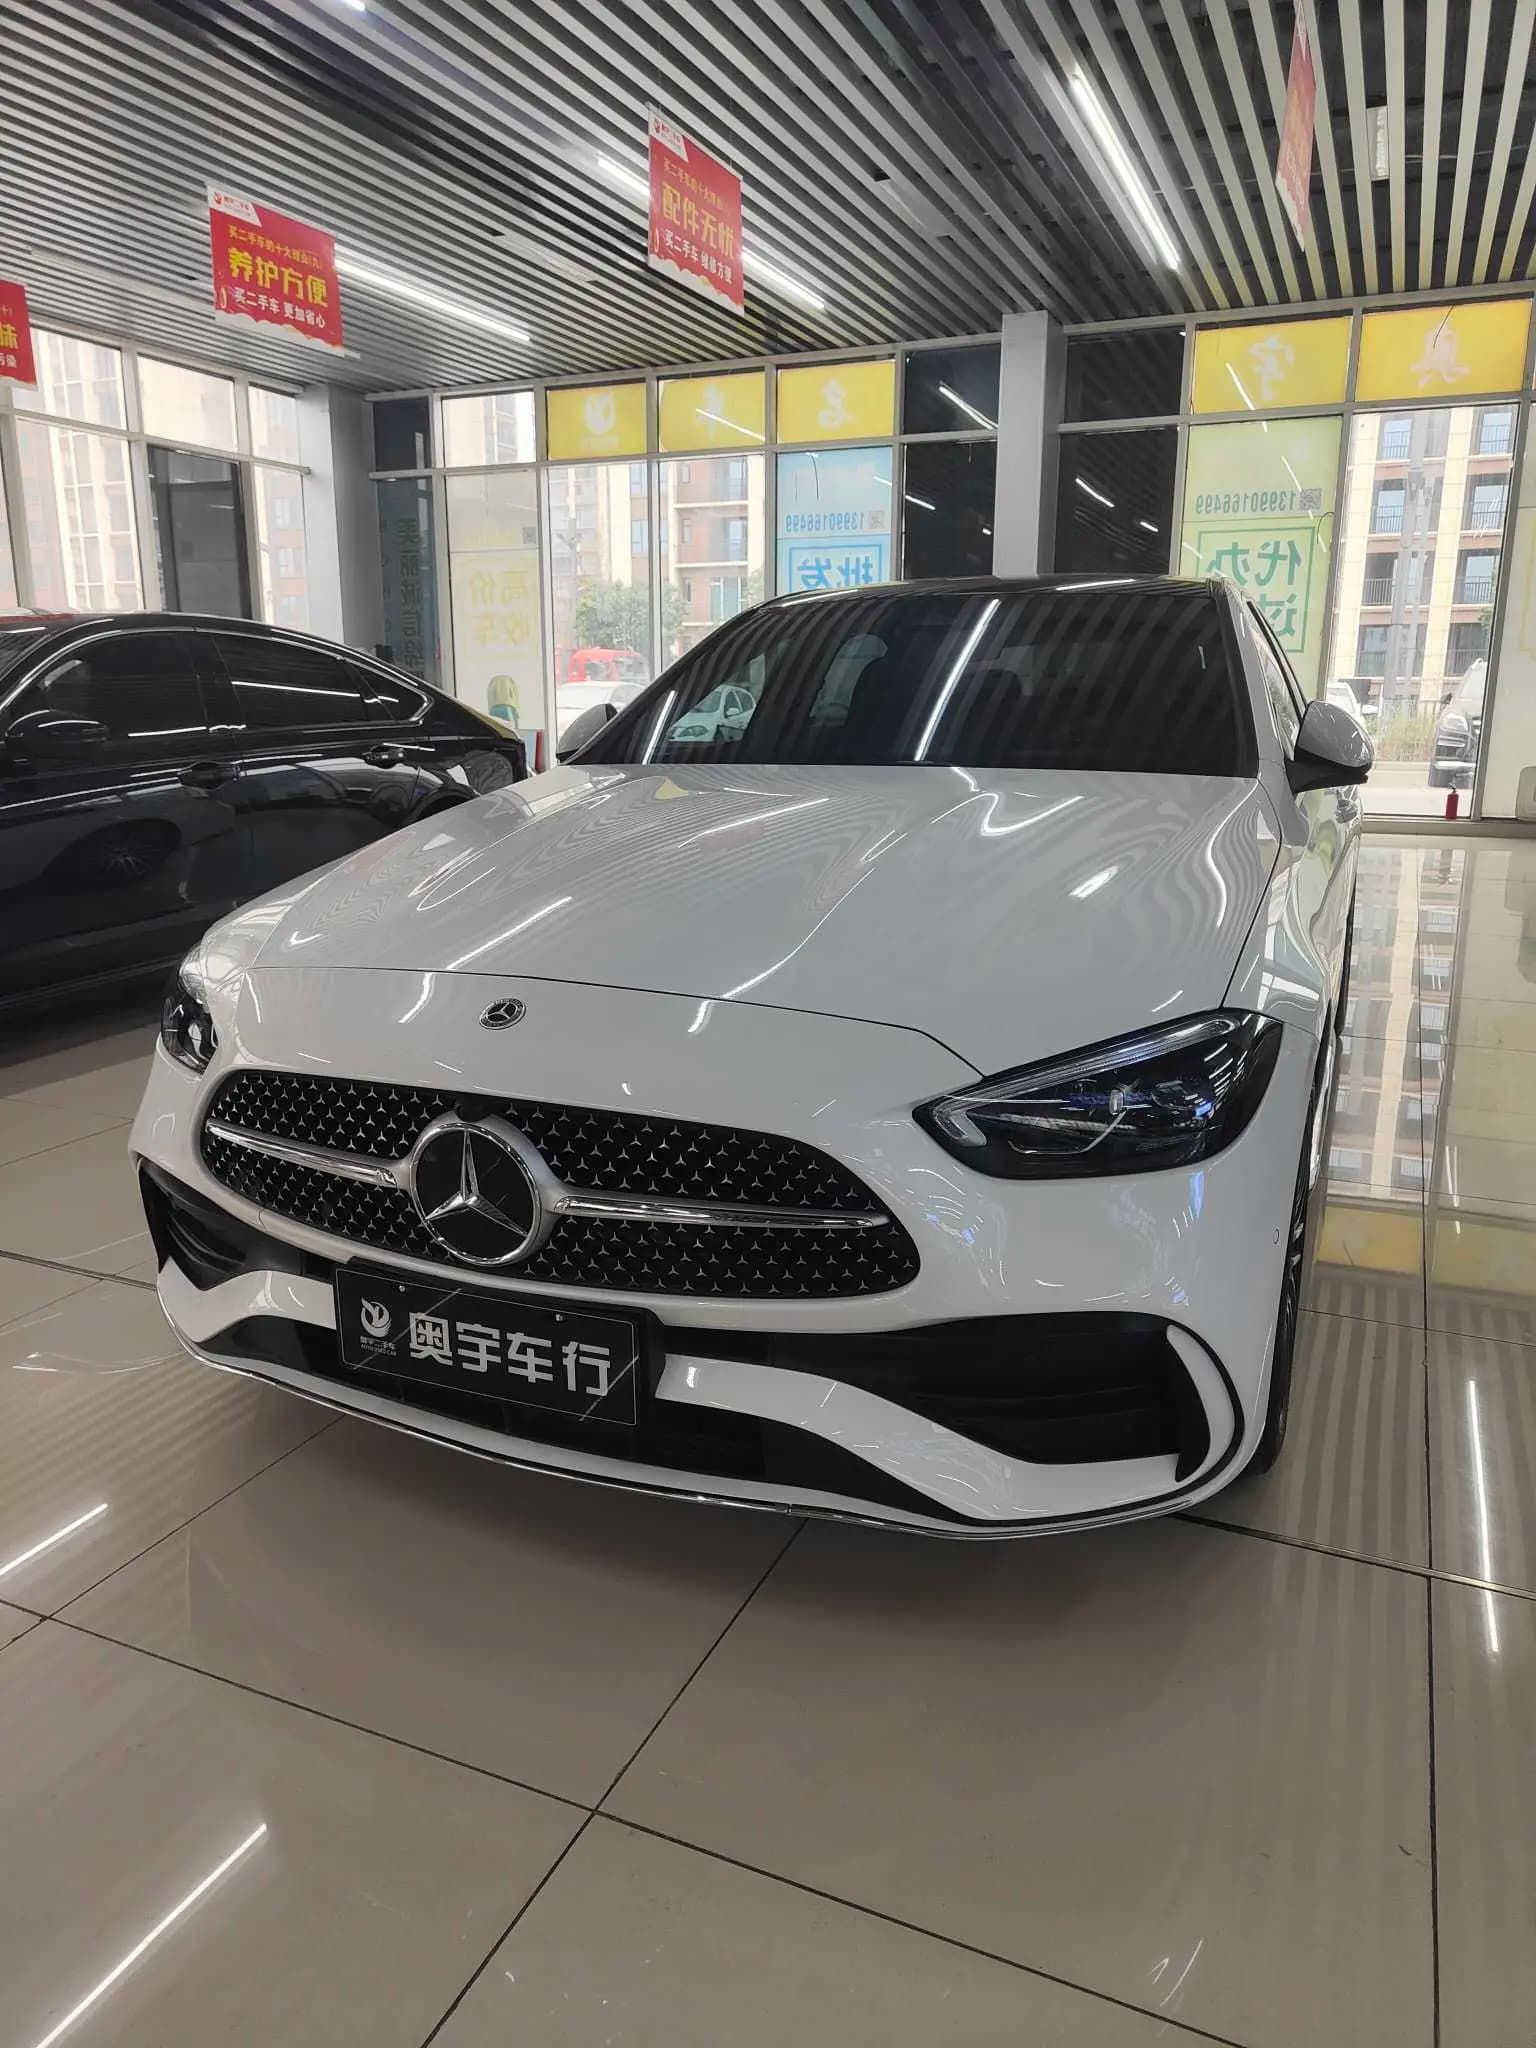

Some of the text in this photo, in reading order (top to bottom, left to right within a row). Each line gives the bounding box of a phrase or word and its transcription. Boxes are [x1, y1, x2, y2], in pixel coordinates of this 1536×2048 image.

[661, 182, 736, 260] 配件无忧
[228, 247, 329, 308] 养护方便
[664, 228, 733, 284] 买二手车 维修方便
[233, 286, 327, 329] 买二手车 更加省心
[408, 1311, 611, 1397] 奥宇车行
